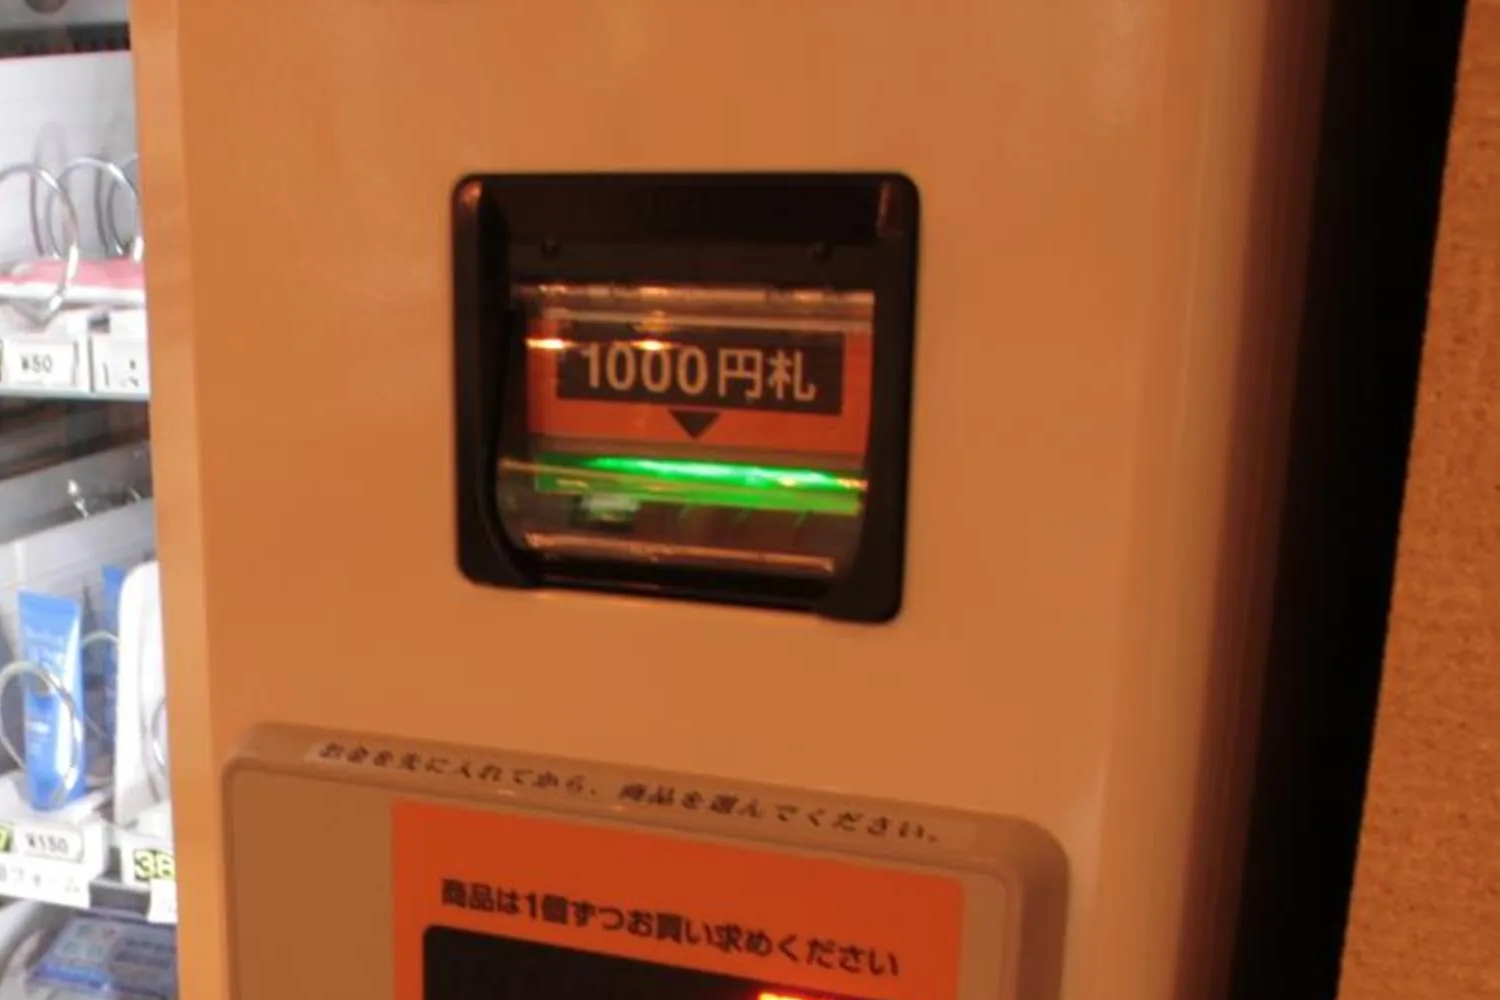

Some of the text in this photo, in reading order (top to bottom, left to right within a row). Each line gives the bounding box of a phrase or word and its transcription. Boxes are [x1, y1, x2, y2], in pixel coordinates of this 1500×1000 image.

[580, 344, 817, 402] 1000円札
[441, 877, 899, 977] 商品は1個ずつお買い求めください
